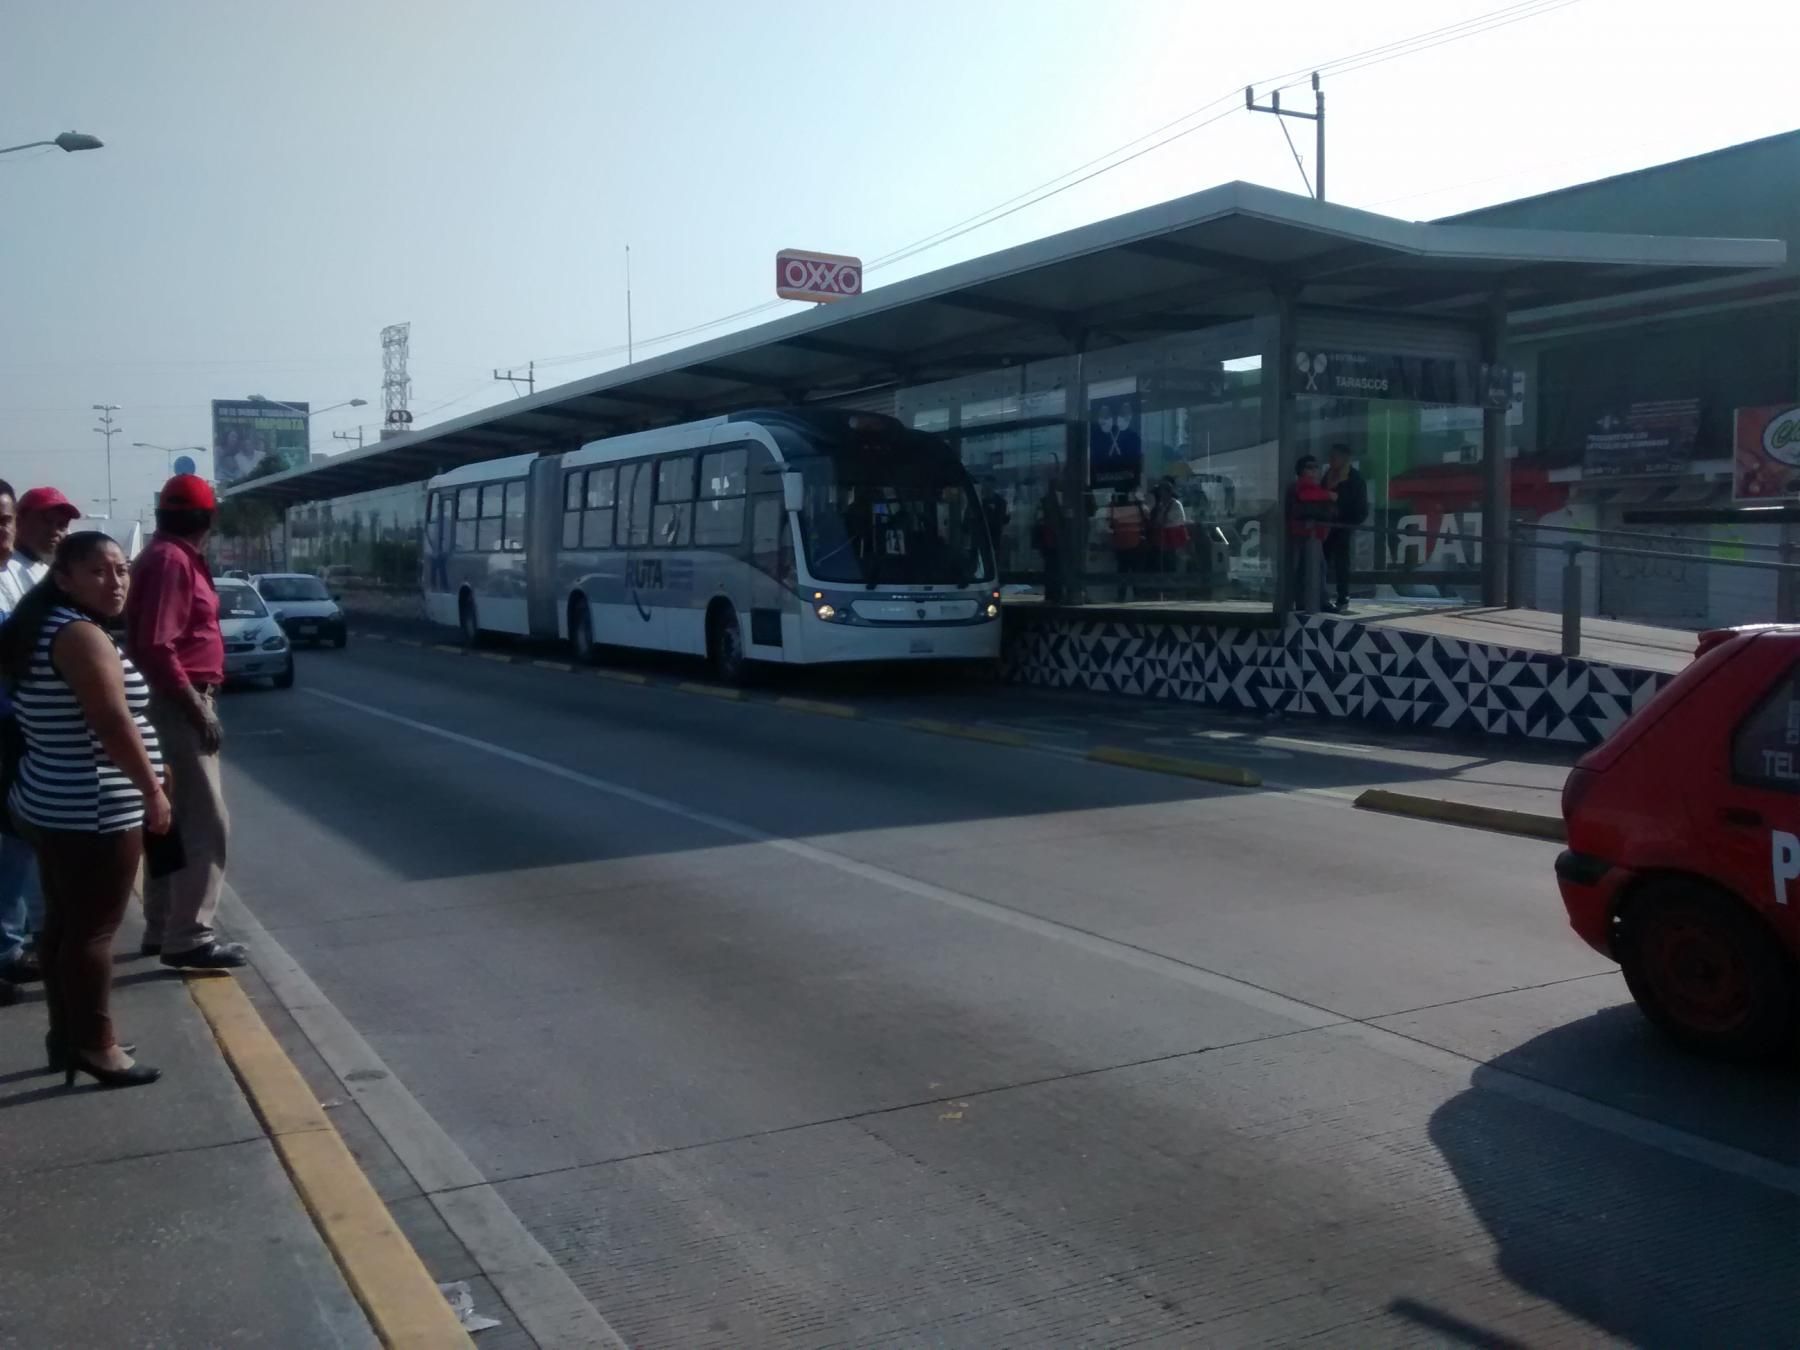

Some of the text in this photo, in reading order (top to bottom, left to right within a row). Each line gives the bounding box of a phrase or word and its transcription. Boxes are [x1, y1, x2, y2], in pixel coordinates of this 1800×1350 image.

[785, 260, 860, 294] OXXO
[1335, 375, 1389, 391] TARASCOS
[625, 559, 664, 589] RUTA
